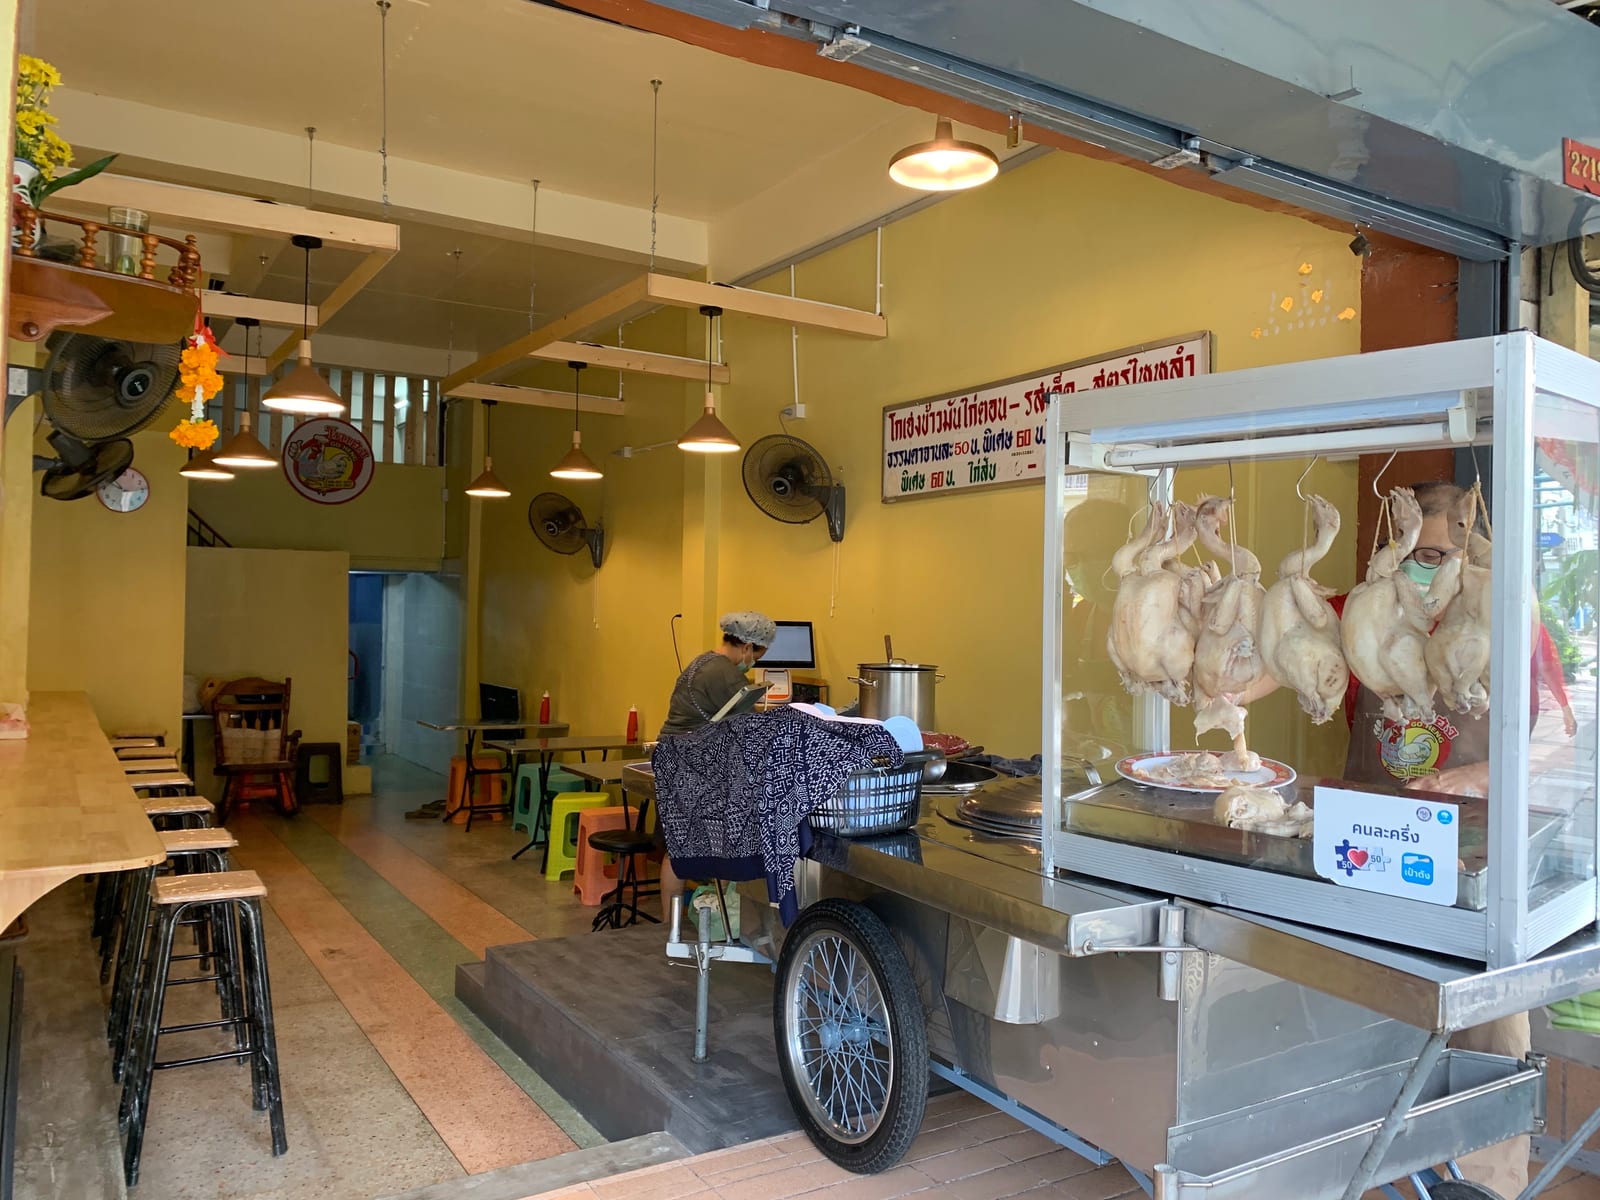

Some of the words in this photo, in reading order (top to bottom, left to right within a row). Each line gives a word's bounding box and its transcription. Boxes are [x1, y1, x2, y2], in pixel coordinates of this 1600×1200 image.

[1016, 429, 1032, 448] 60
[901, 469, 926, 493] พิเศษ
[930, 471, 944, 489] 60
[1352, 823, 1420, 843] คนละครึ่ง
[1341, 860, 1353, 869] 50
[1370, 854, 1382, 863] 50
